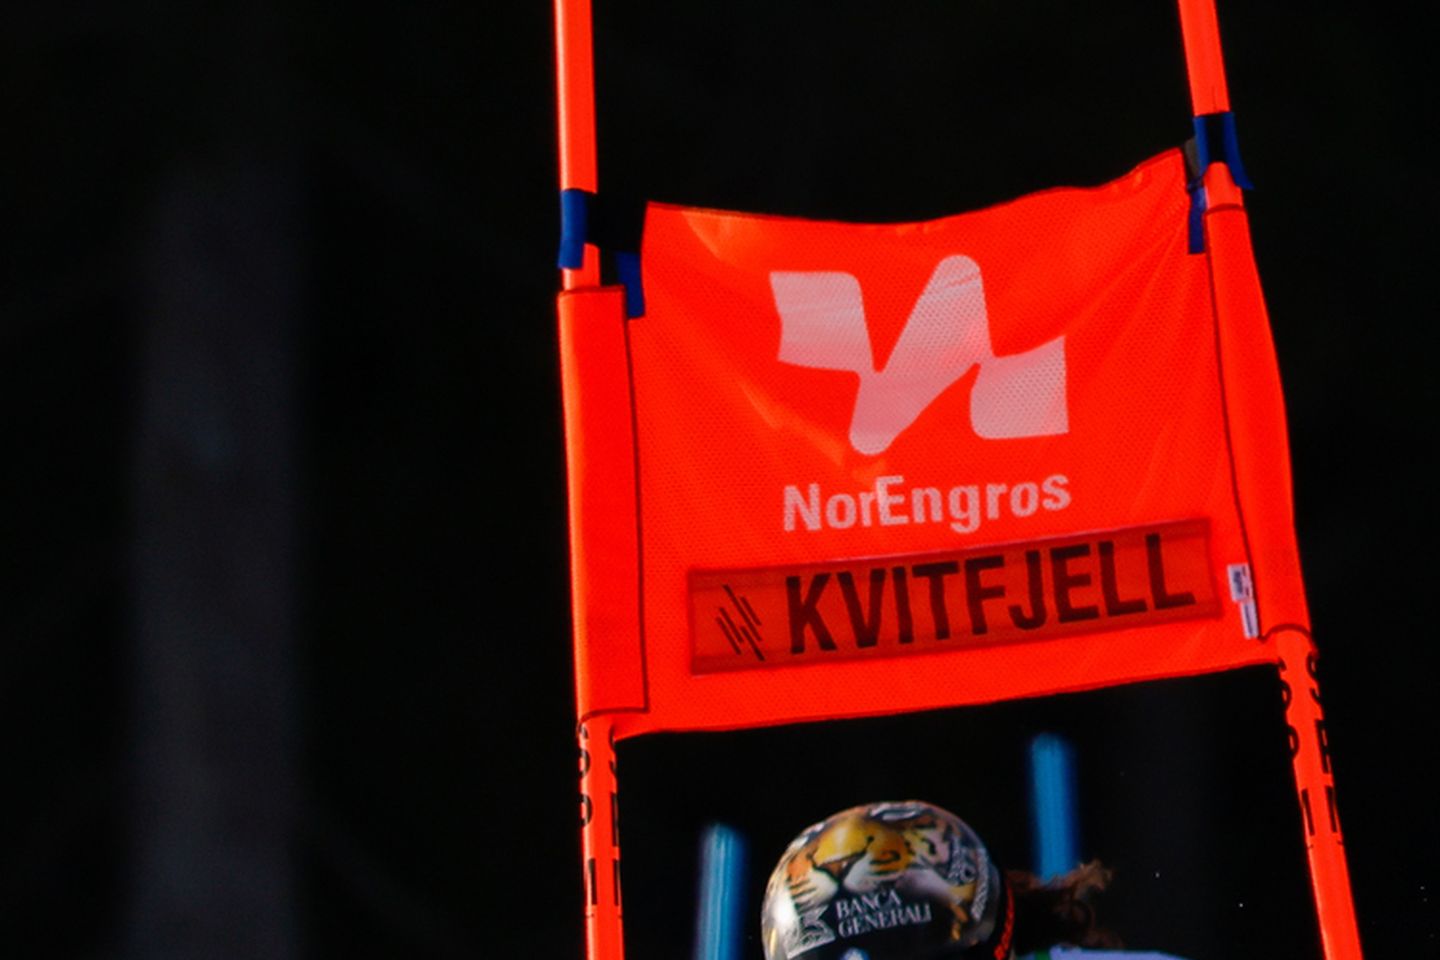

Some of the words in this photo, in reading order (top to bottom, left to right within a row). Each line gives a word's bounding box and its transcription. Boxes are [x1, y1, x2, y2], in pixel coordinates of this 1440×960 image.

[782, 474, 1072, 533] NorEngros
[786, 532, 1197, 656] KVITFJELL
[835, 887, 902, 918] BANCA
[838, 902, 933, 939] GENERALI
